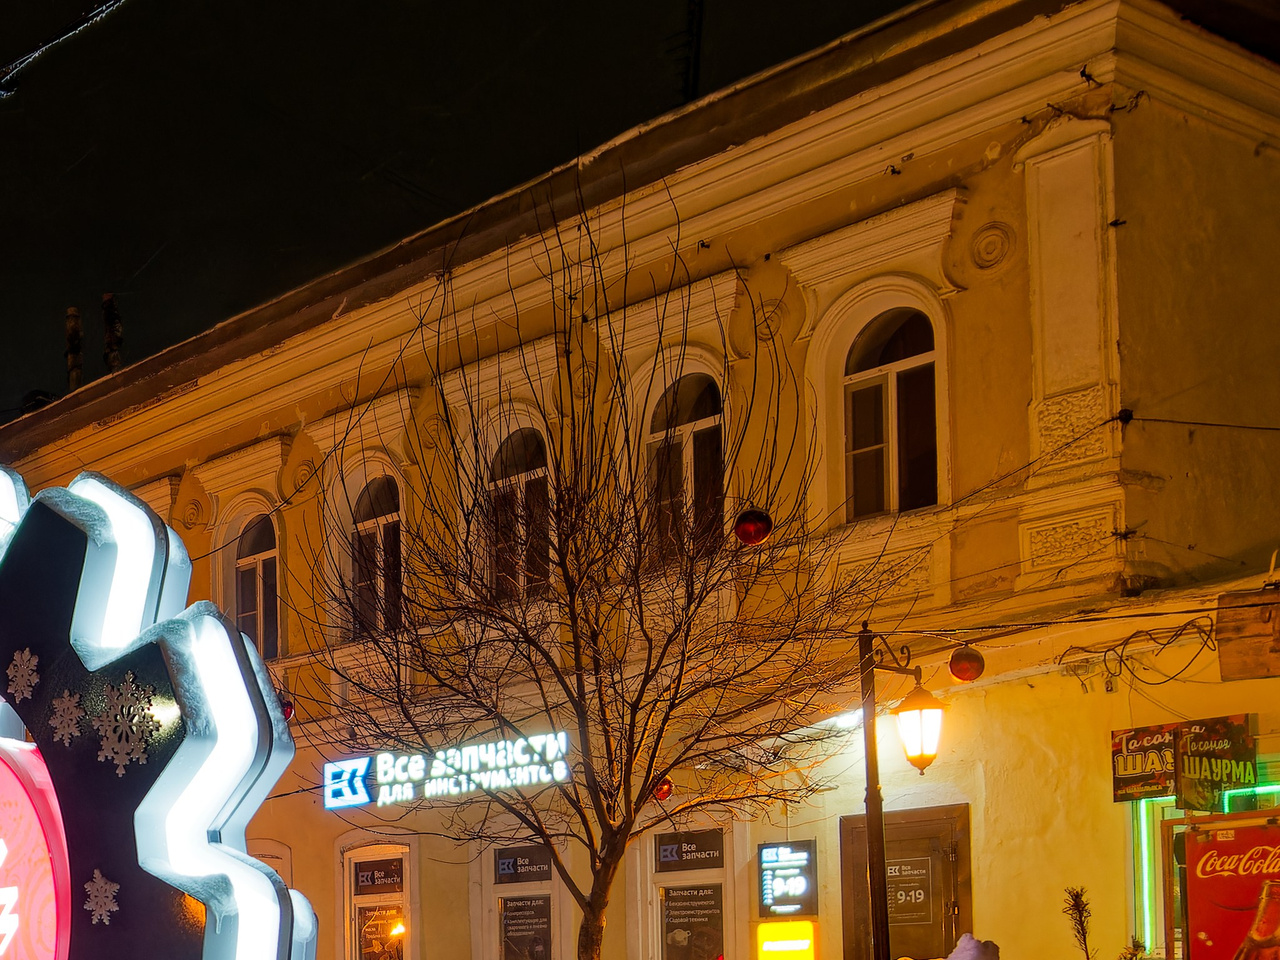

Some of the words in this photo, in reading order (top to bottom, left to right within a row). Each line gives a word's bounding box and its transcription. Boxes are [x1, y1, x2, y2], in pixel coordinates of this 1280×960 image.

[376, 752, 426, 783] Все
[431, 731, 568, 775] запчасти
[1182, 755, 1255, 783] ШАУРМА
[682, 843, 697, 851] Все
[682, 851, 719, 860] запчасти
[517, 857, 529, 865] Все
[1196, 845, 1280, 879] Coca-Cola
[517, 865, 548, 873] запчасти
[374, 870, 385, 879] Все
